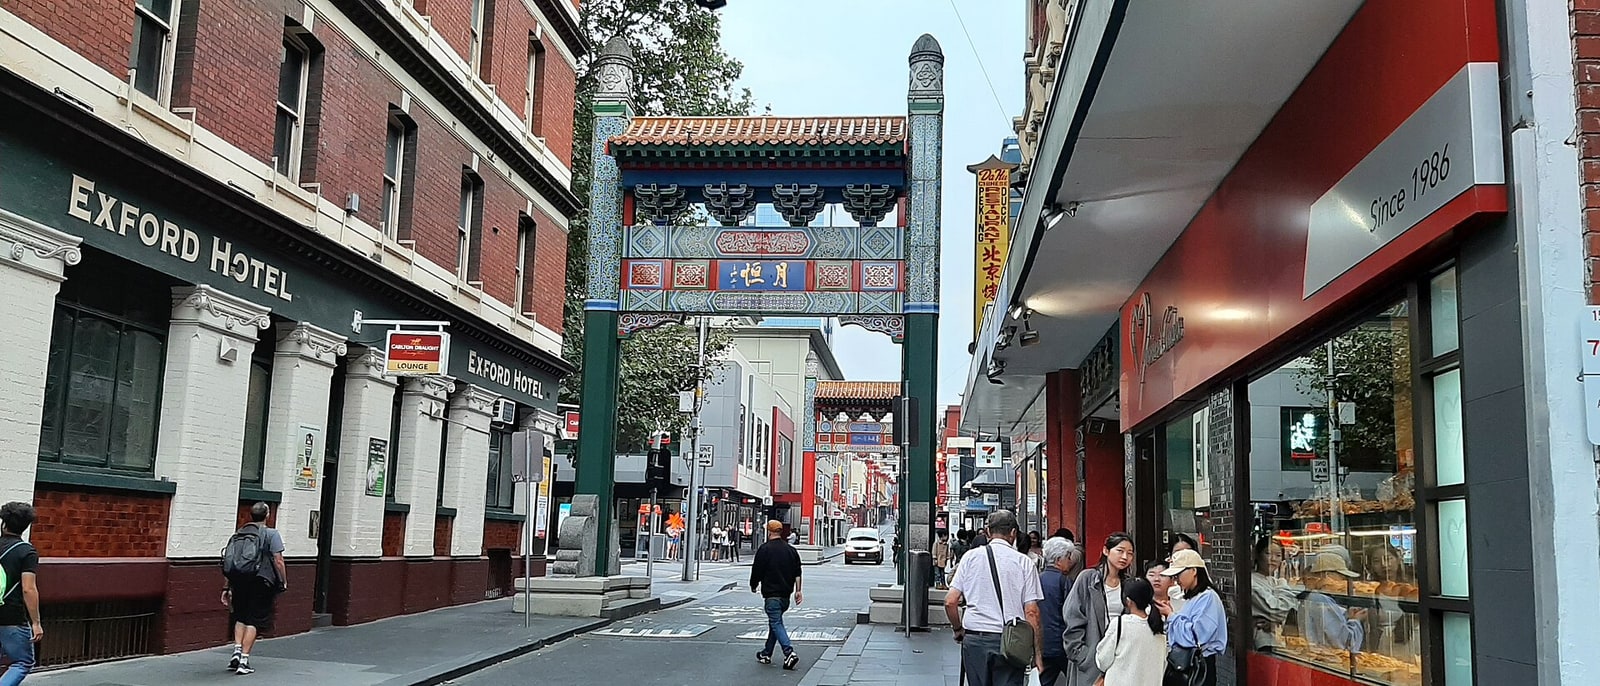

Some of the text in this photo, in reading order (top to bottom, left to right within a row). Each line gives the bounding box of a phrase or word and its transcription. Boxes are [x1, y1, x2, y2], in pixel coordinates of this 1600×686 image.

[1370, 143, 1450, 233] Since 1986
[68, 173, 293, 302] EXFORD HOTEL
[468, 350, 543, 400] EXFORD HOTEL
